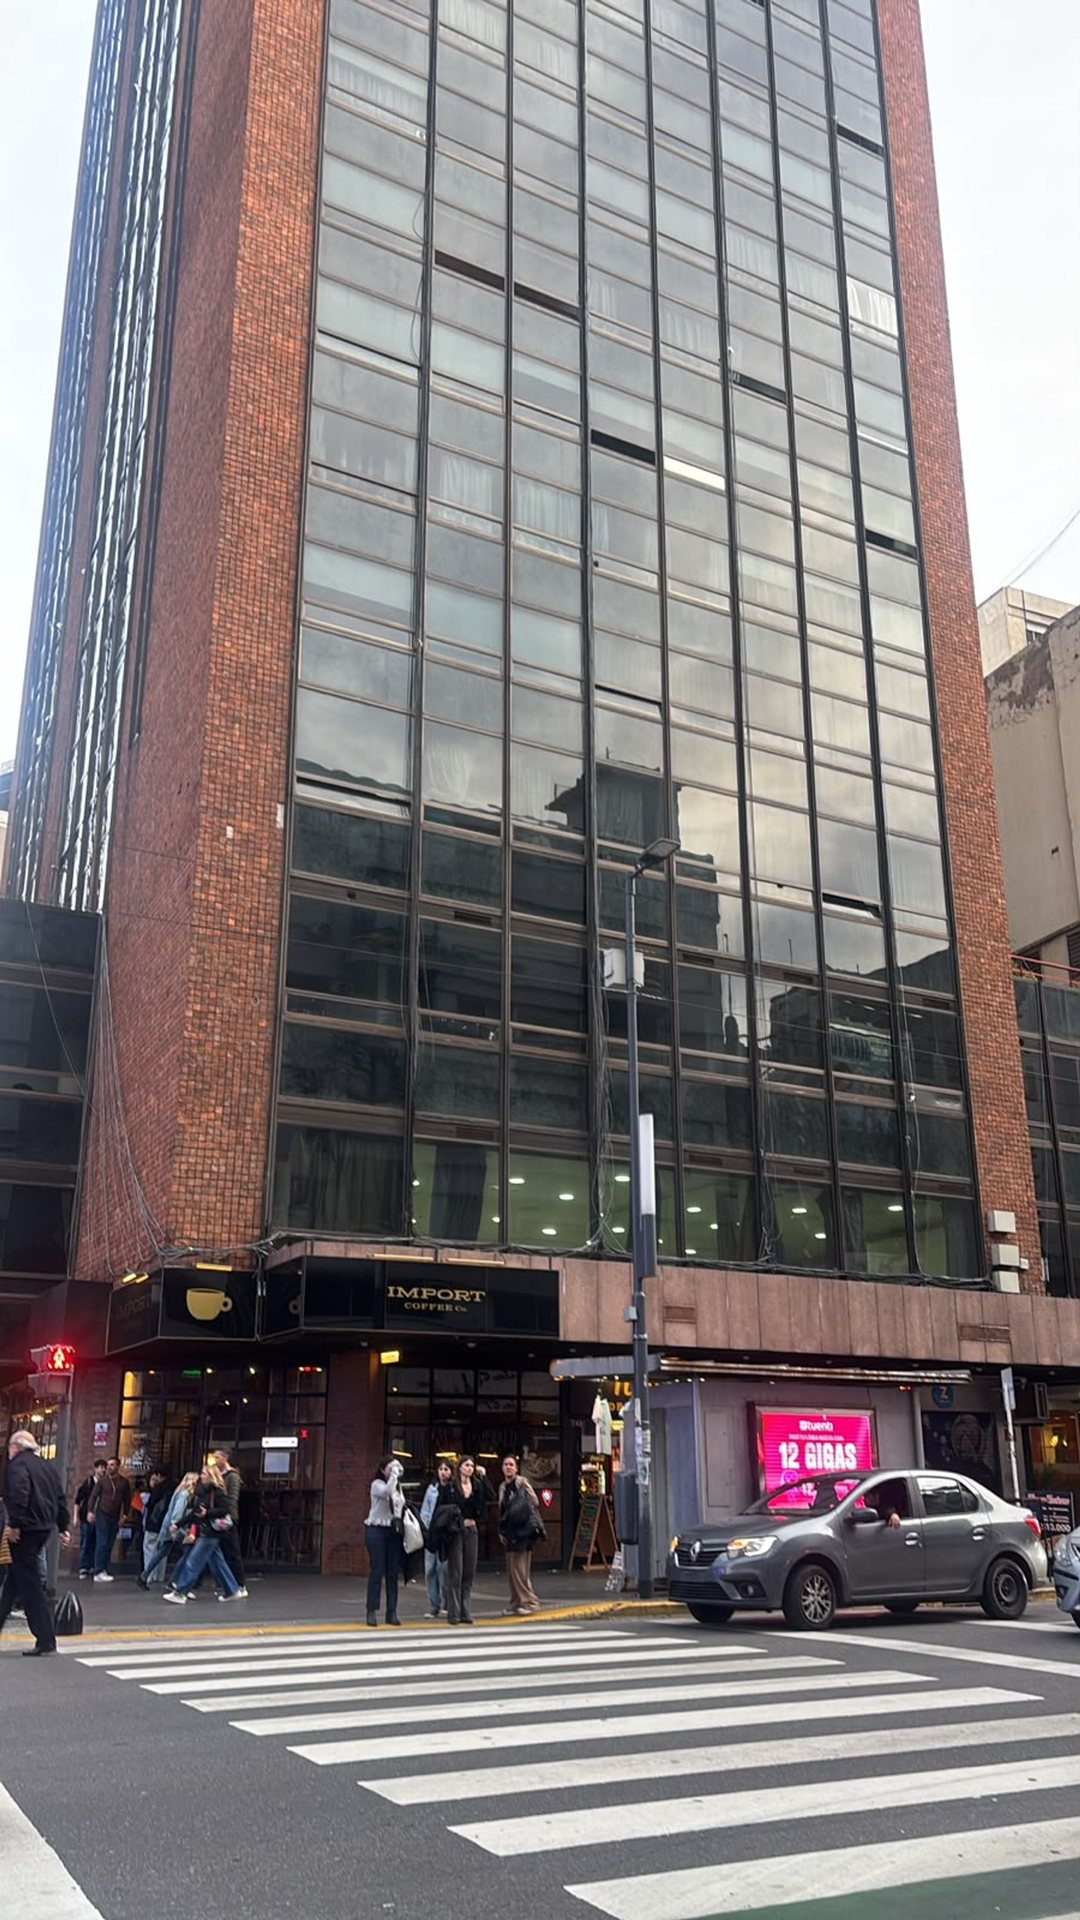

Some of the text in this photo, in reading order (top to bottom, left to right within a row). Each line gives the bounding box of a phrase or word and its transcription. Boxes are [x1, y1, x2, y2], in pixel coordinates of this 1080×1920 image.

[387, 1286, 486, 1302] IMPORT
[404, 1302, 453, 1312] COFFEE
[939, 1386, 949, 1400] Z
[779, 1442, 857, 1470] 12 GIGAS
